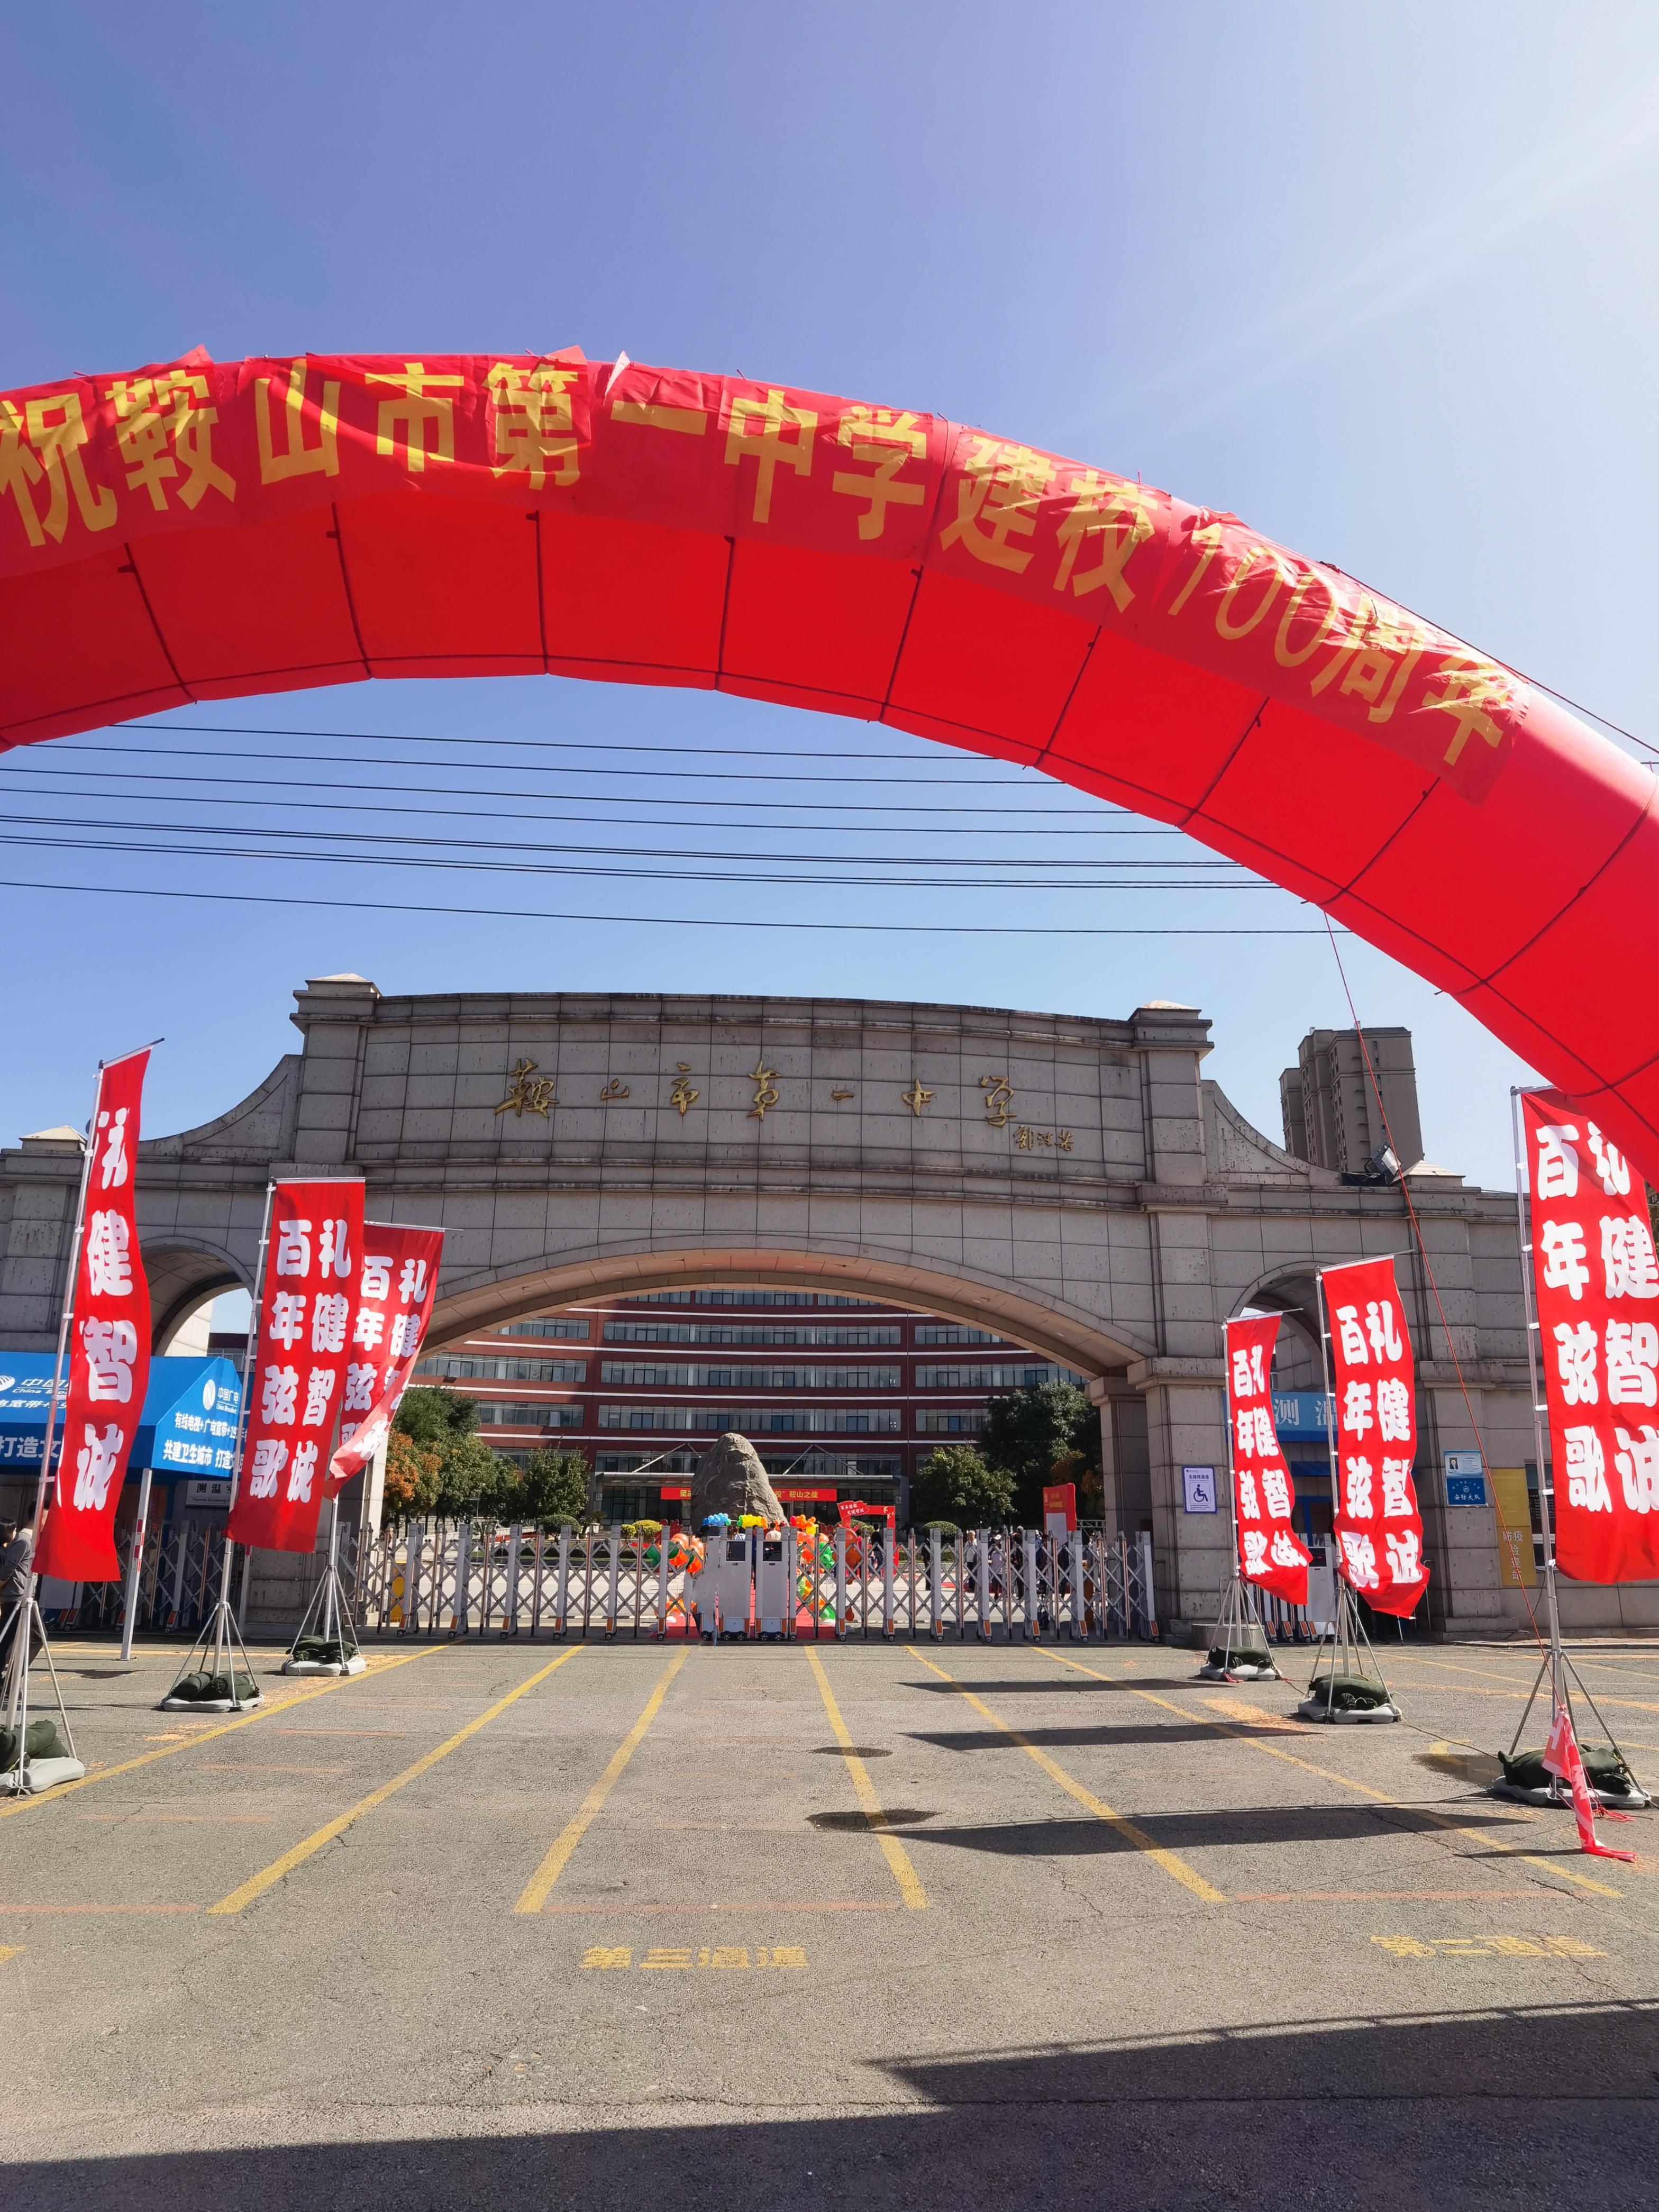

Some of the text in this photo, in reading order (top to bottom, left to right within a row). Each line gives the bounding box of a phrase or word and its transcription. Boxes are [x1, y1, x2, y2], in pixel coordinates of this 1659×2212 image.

[0, 359, 1516, 766] 祝鞍山市第一中学建校100周年
[21, 1378, 68, 1388] 中国
[217, 1387, 239, 1404] 中国广电
[250, 1219, 312, 1500] 百年弦歌
[291, 1218, 352, 1503] 礼健智诚
[1274, 1398, 1338, 1426] 测温
[1365, 1300, 1423, 1583] 礼健智诚
[1536, 1124, 1612, 1513] 百年弦歌
[1587, 1121, 1659, 1514] 礼健智诚
[162, 1439, 213, 1467] 共建卫生城市
[1233, 1349, 1272, 1576] 百年弦歌
[1251, 1344, 1307, 1567] 礼健智诚
[1336, 1305, 1380, 1589] 百年弦歌
[1503, 1531, 1524, 1542] 防疫
